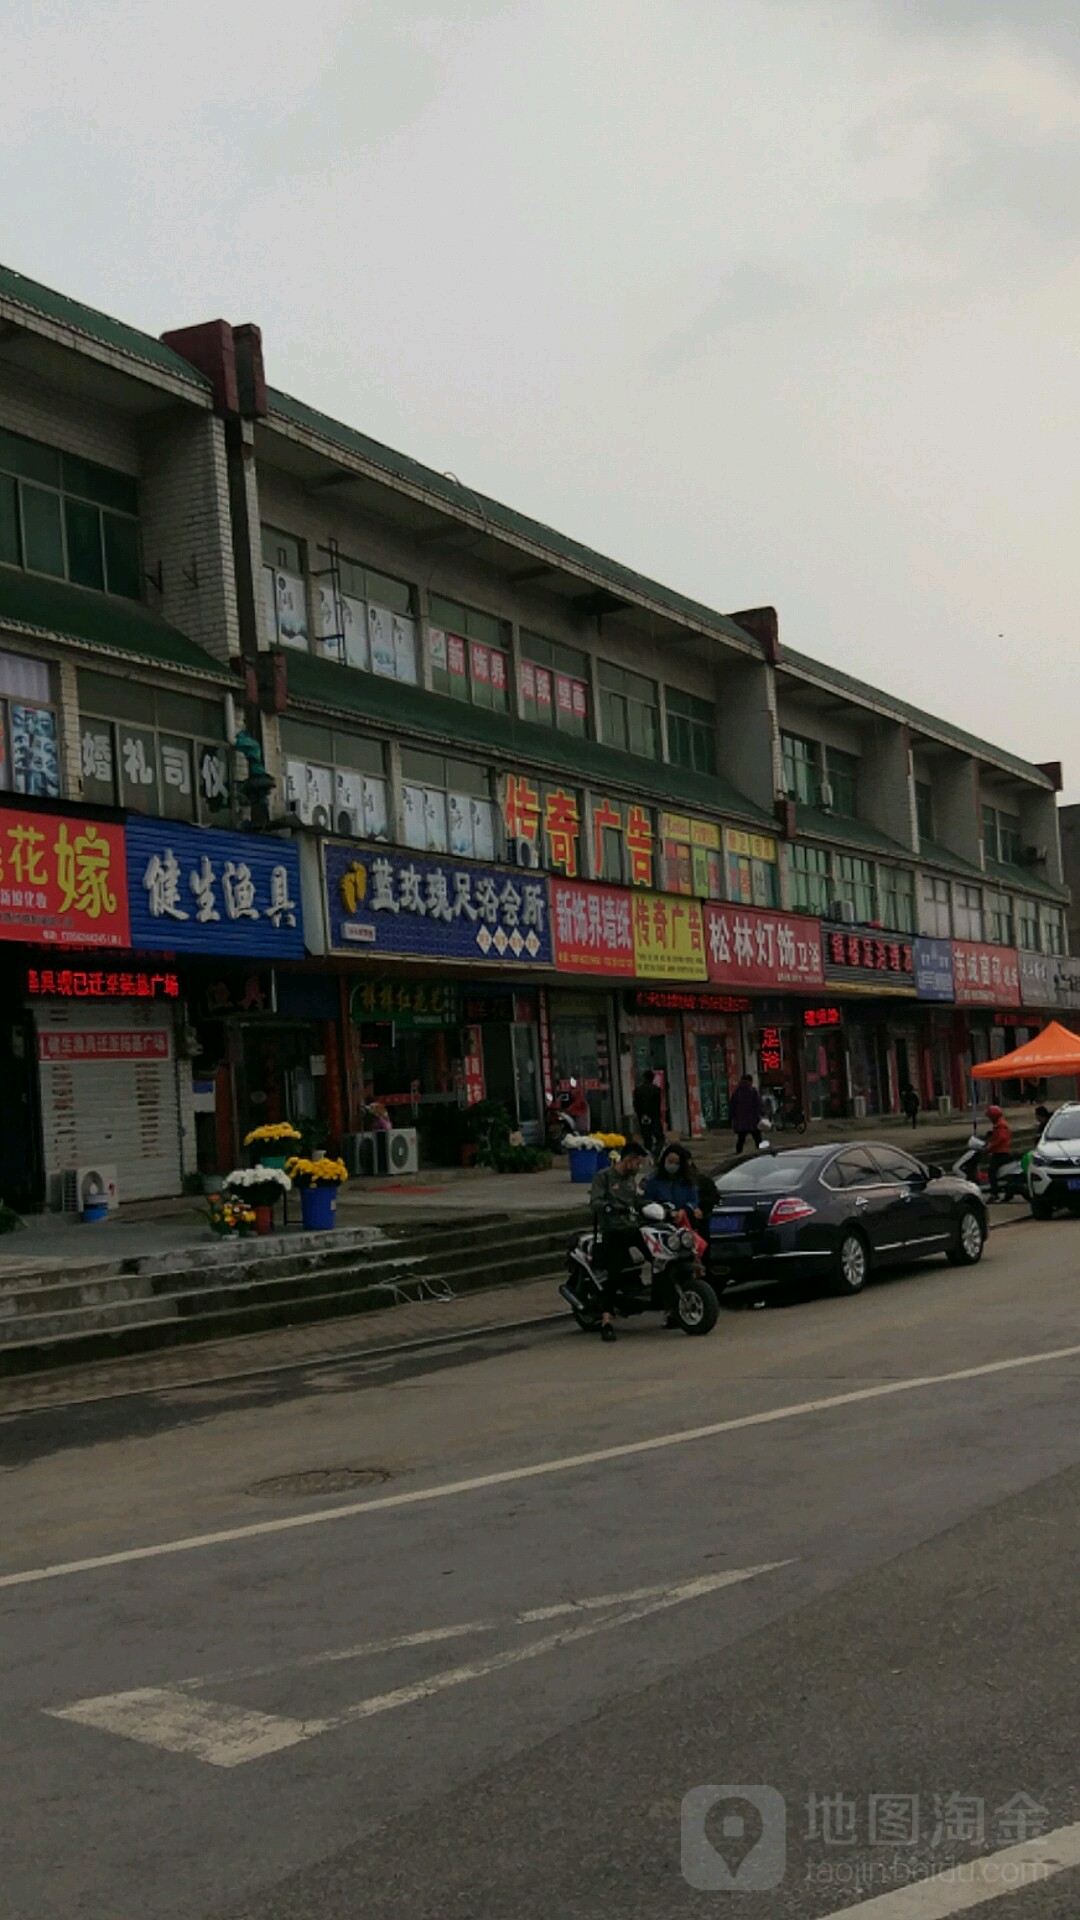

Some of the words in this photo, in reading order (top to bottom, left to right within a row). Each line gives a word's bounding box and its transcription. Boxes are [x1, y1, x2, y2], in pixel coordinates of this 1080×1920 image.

[82, 731, 228, 802] 婚礼司仪
[506, 774, 652, 887] 传奇广告
[0, 822, 117, 919] 花嫁
[143, 849, 296, 928] 健生渔具
[370, 857, 545, 931] 蓝玫瑰足浴会所
[556, 888, 632, 950] 新饰界墙纸
[635, 896, 702, 951] 传奇广告
[709, 911, 796, 972] 松林灯饰
[797, 940, 820, 973] 卫浴
[761, 1028, 780, 1072] 足浴
